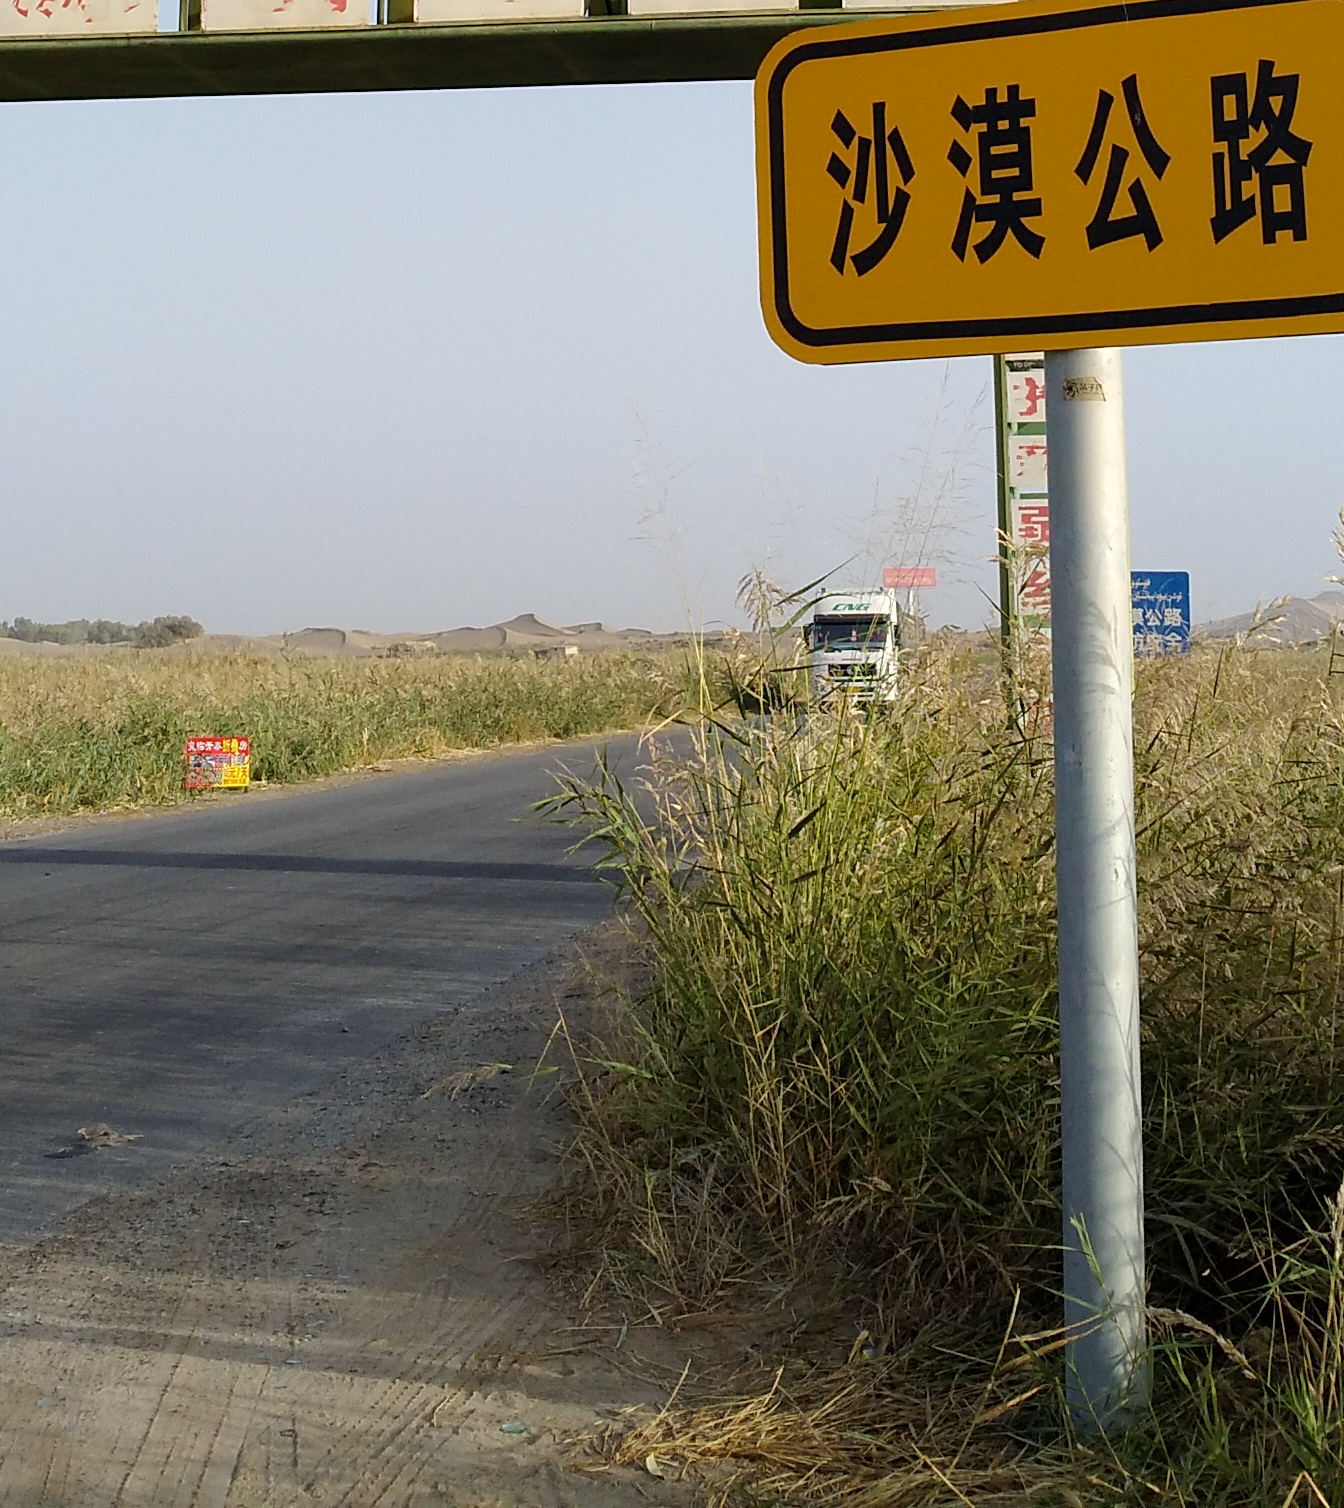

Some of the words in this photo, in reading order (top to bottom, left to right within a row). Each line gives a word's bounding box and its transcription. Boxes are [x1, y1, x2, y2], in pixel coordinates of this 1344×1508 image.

[825, 59, 1313, 277] 沙漠公路
[832, 602, 871, 612] CNG
